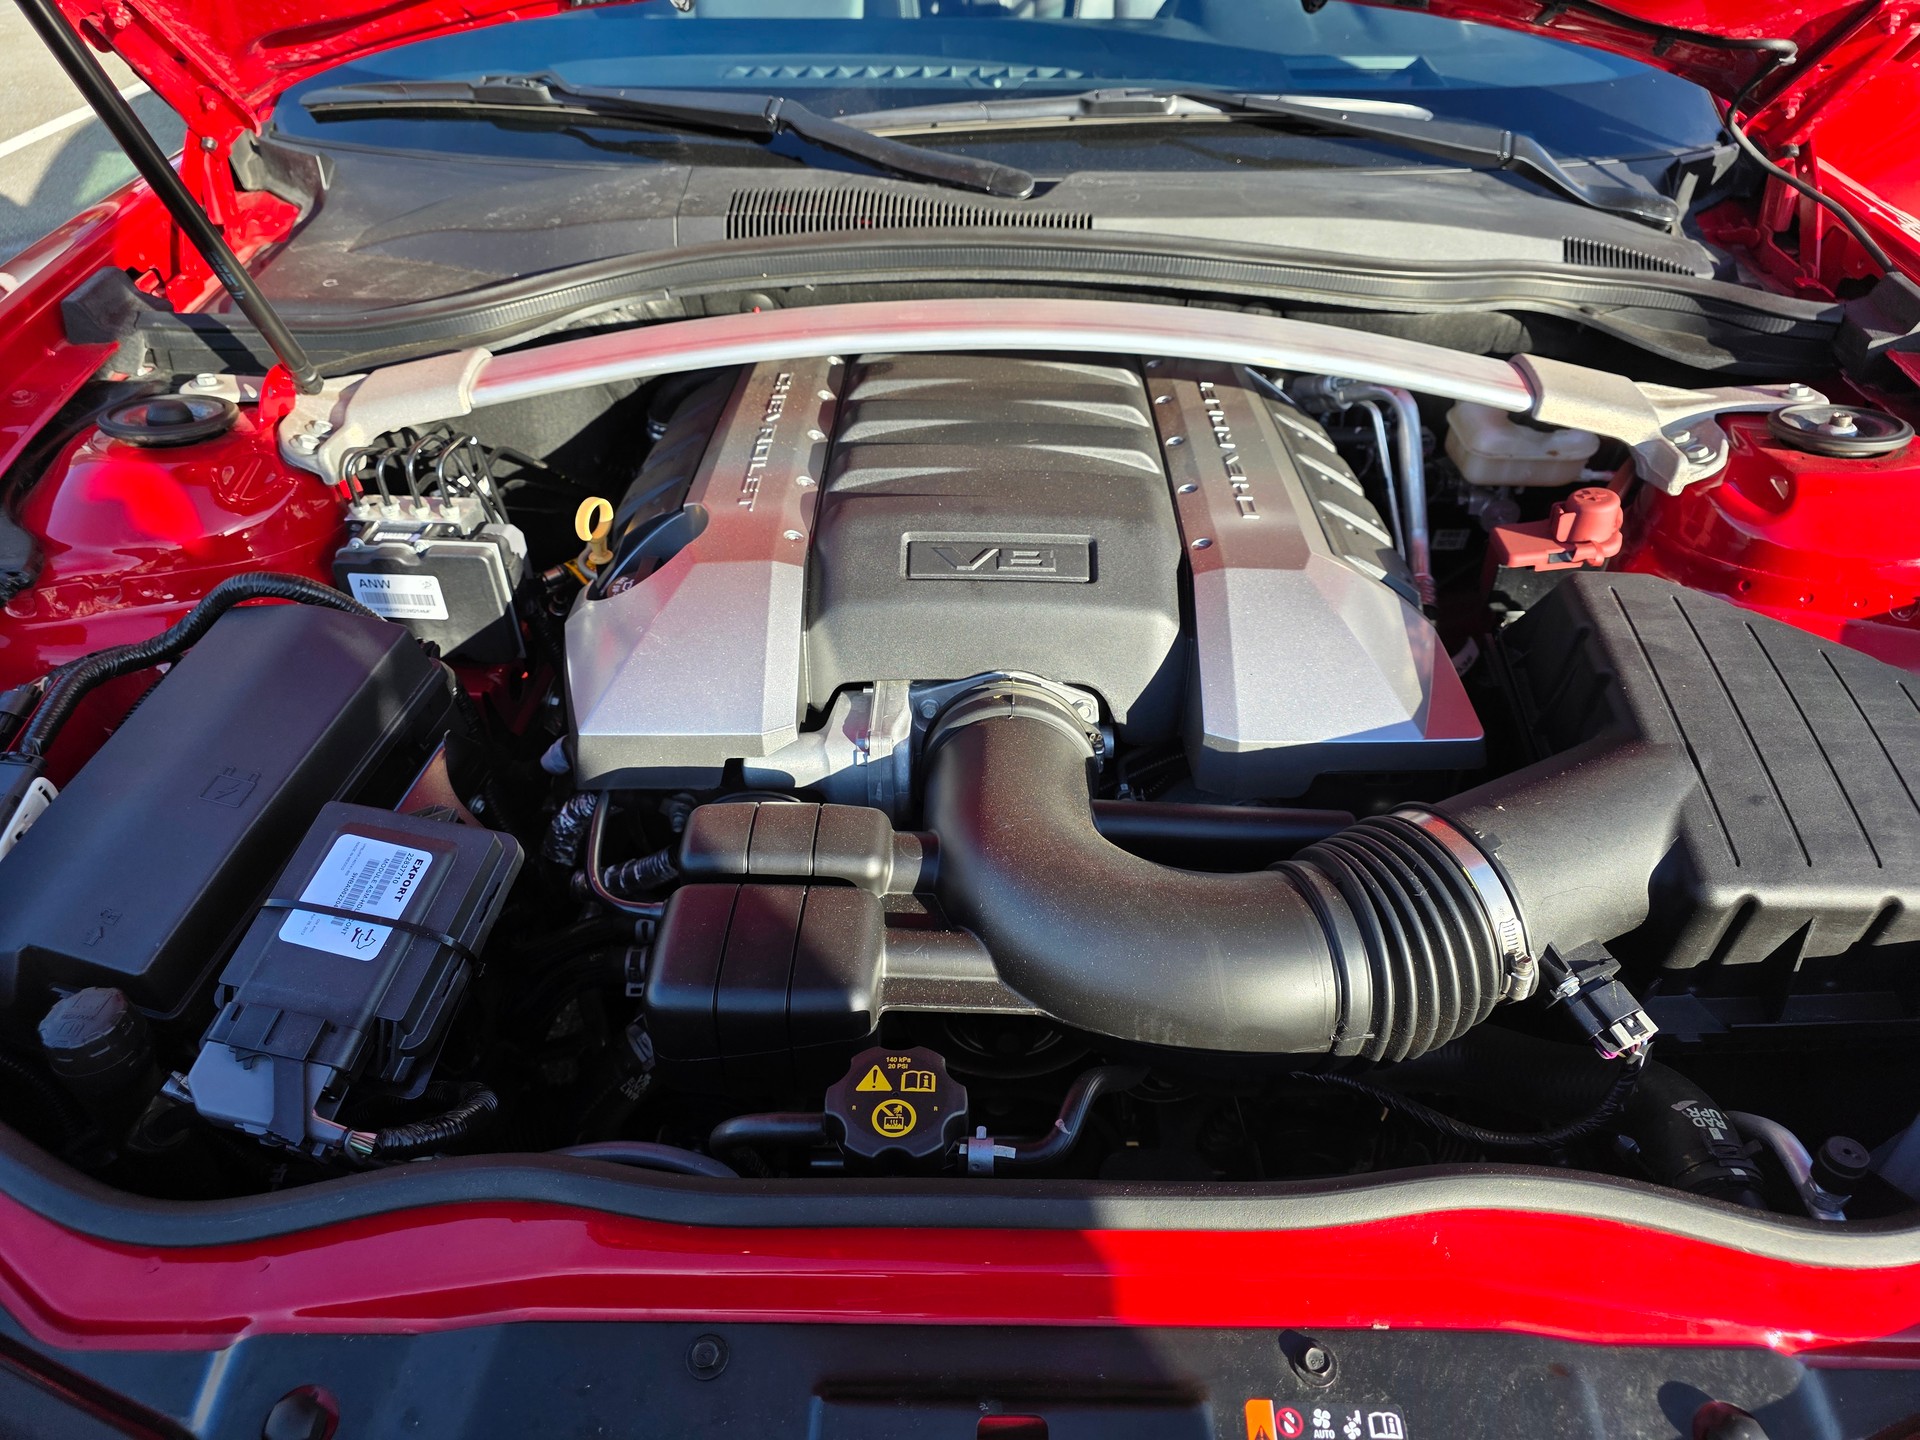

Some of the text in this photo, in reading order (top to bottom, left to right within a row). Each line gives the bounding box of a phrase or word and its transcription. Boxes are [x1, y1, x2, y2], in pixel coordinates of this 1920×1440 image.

[738, 371, 794, 512] CHEVROLET
[1200, 381, 1261, 520] CHEVROLET
[930, 546, 1057, 573] V8
[359, 578, 391, 589] ANW
[371, 857, 390, 886] MODULE
[394, 858, 424, 902] EXPORT
[1685, 1107, 1723, 1120] UPR
[1692, 1117, 1728, 1130] RAD
[1313, 1429, 1336, 1439] AUTO
